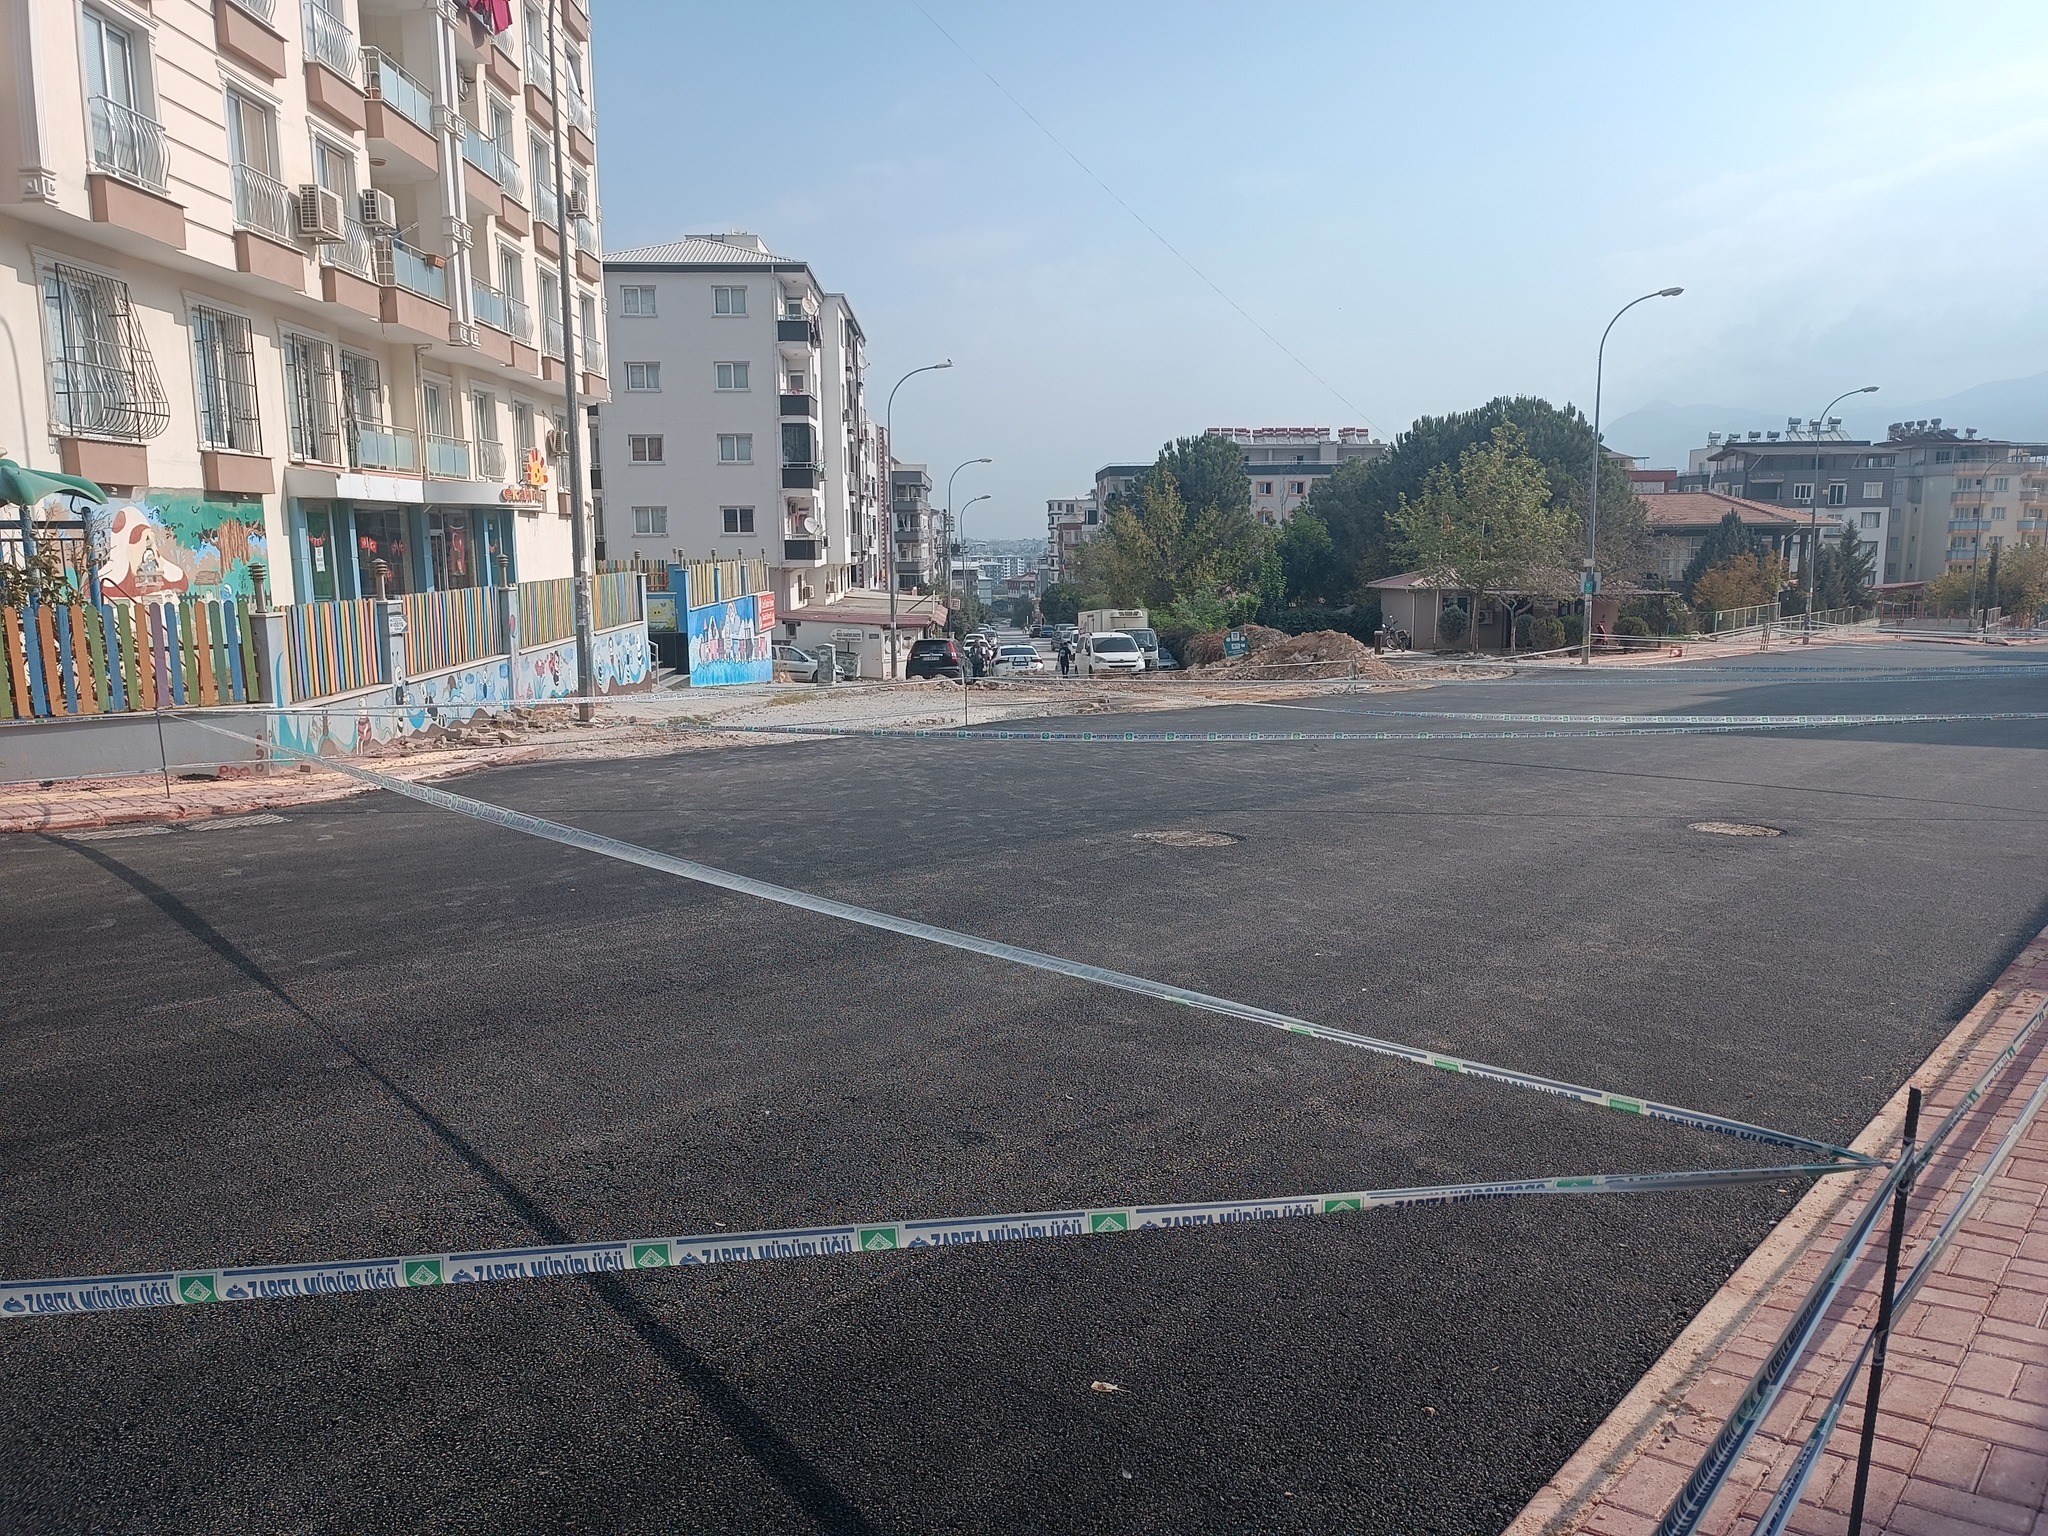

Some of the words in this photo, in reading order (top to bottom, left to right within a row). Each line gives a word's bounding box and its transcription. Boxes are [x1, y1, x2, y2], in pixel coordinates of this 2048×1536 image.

[474, 1263, 526, 1281] ZABITA
[248, 1278, 302, 1298] ZABITA
[24, 1292, 82, 1313] ZABITA
